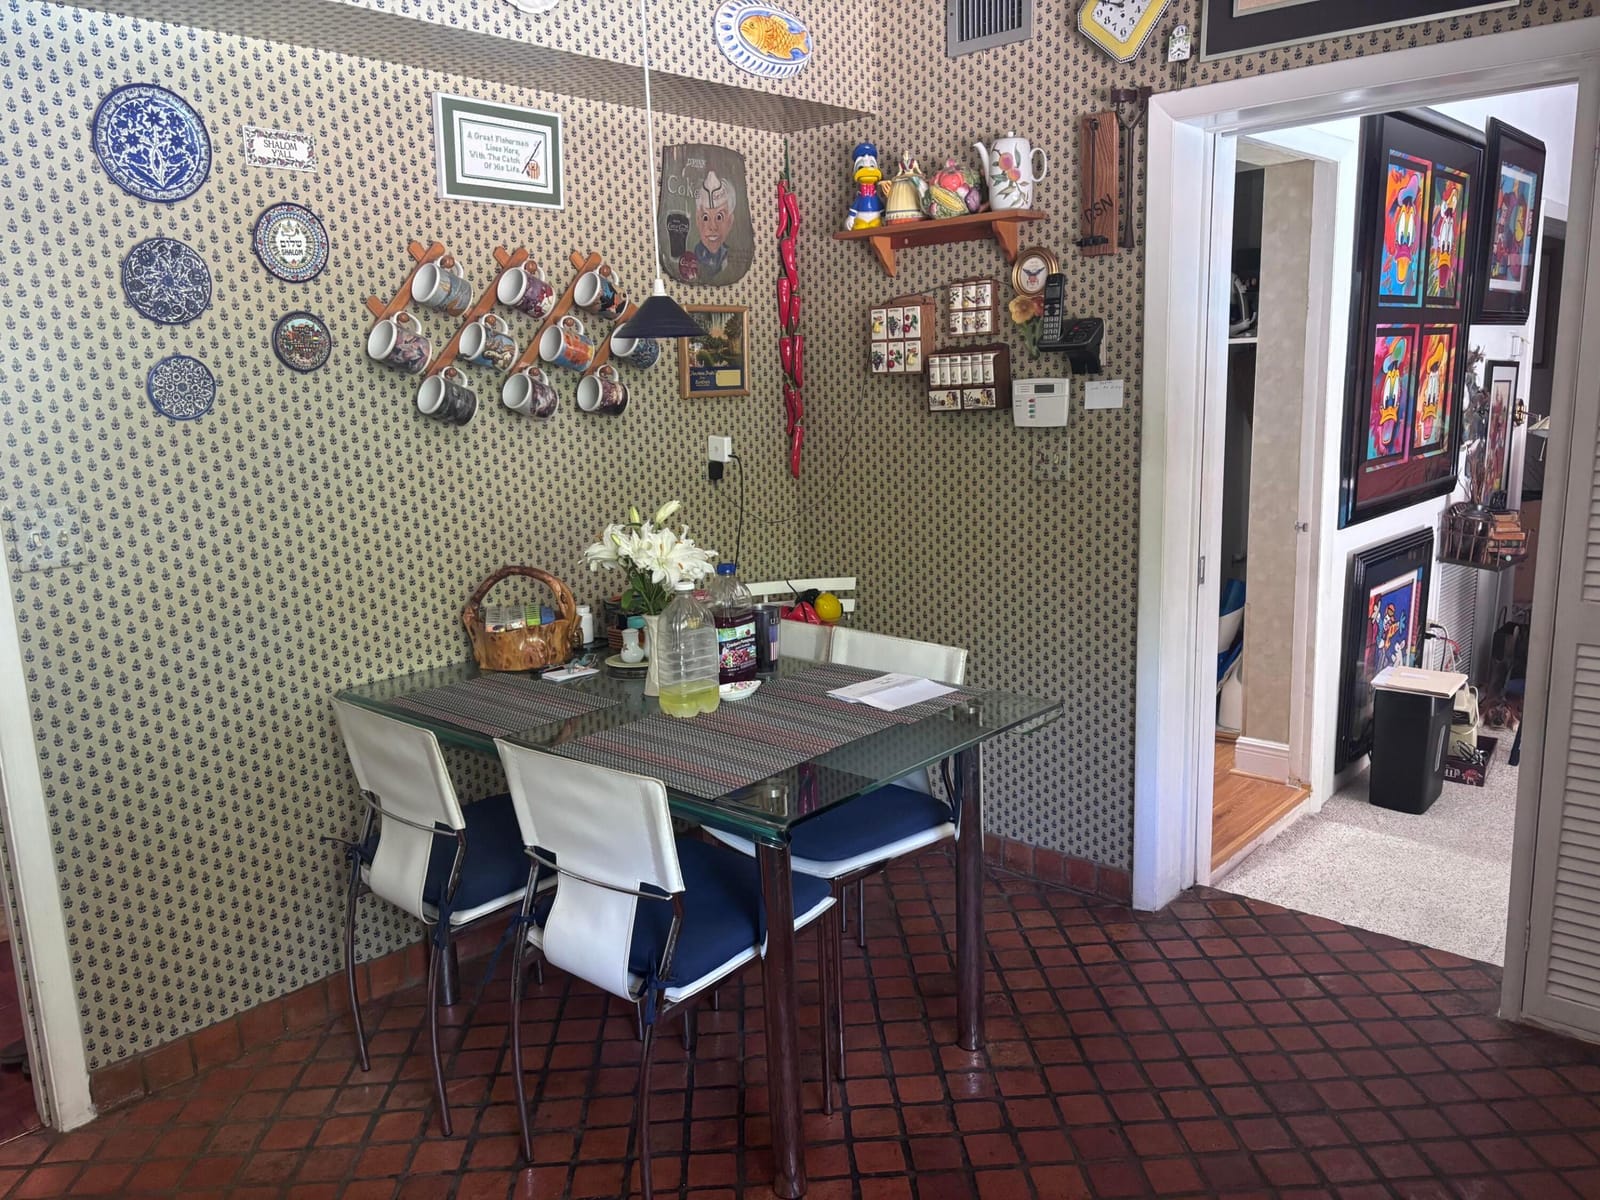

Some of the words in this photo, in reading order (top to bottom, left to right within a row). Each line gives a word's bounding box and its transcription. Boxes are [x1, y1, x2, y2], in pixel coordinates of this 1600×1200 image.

[263, 139, 298, 151] SHALOM
[474, 132, 493, 141] Great
[495, 135, 529, 147] Fisherman
[271, 148, 295, 159] Y'ALL
[469, 150, 486, 159] With
[488, 152, 500, 161] The
[667, 175, 701, 200] Coke
[280, 239, 303, 248] שלום
[280, 248, 304, 256] SHALOM
